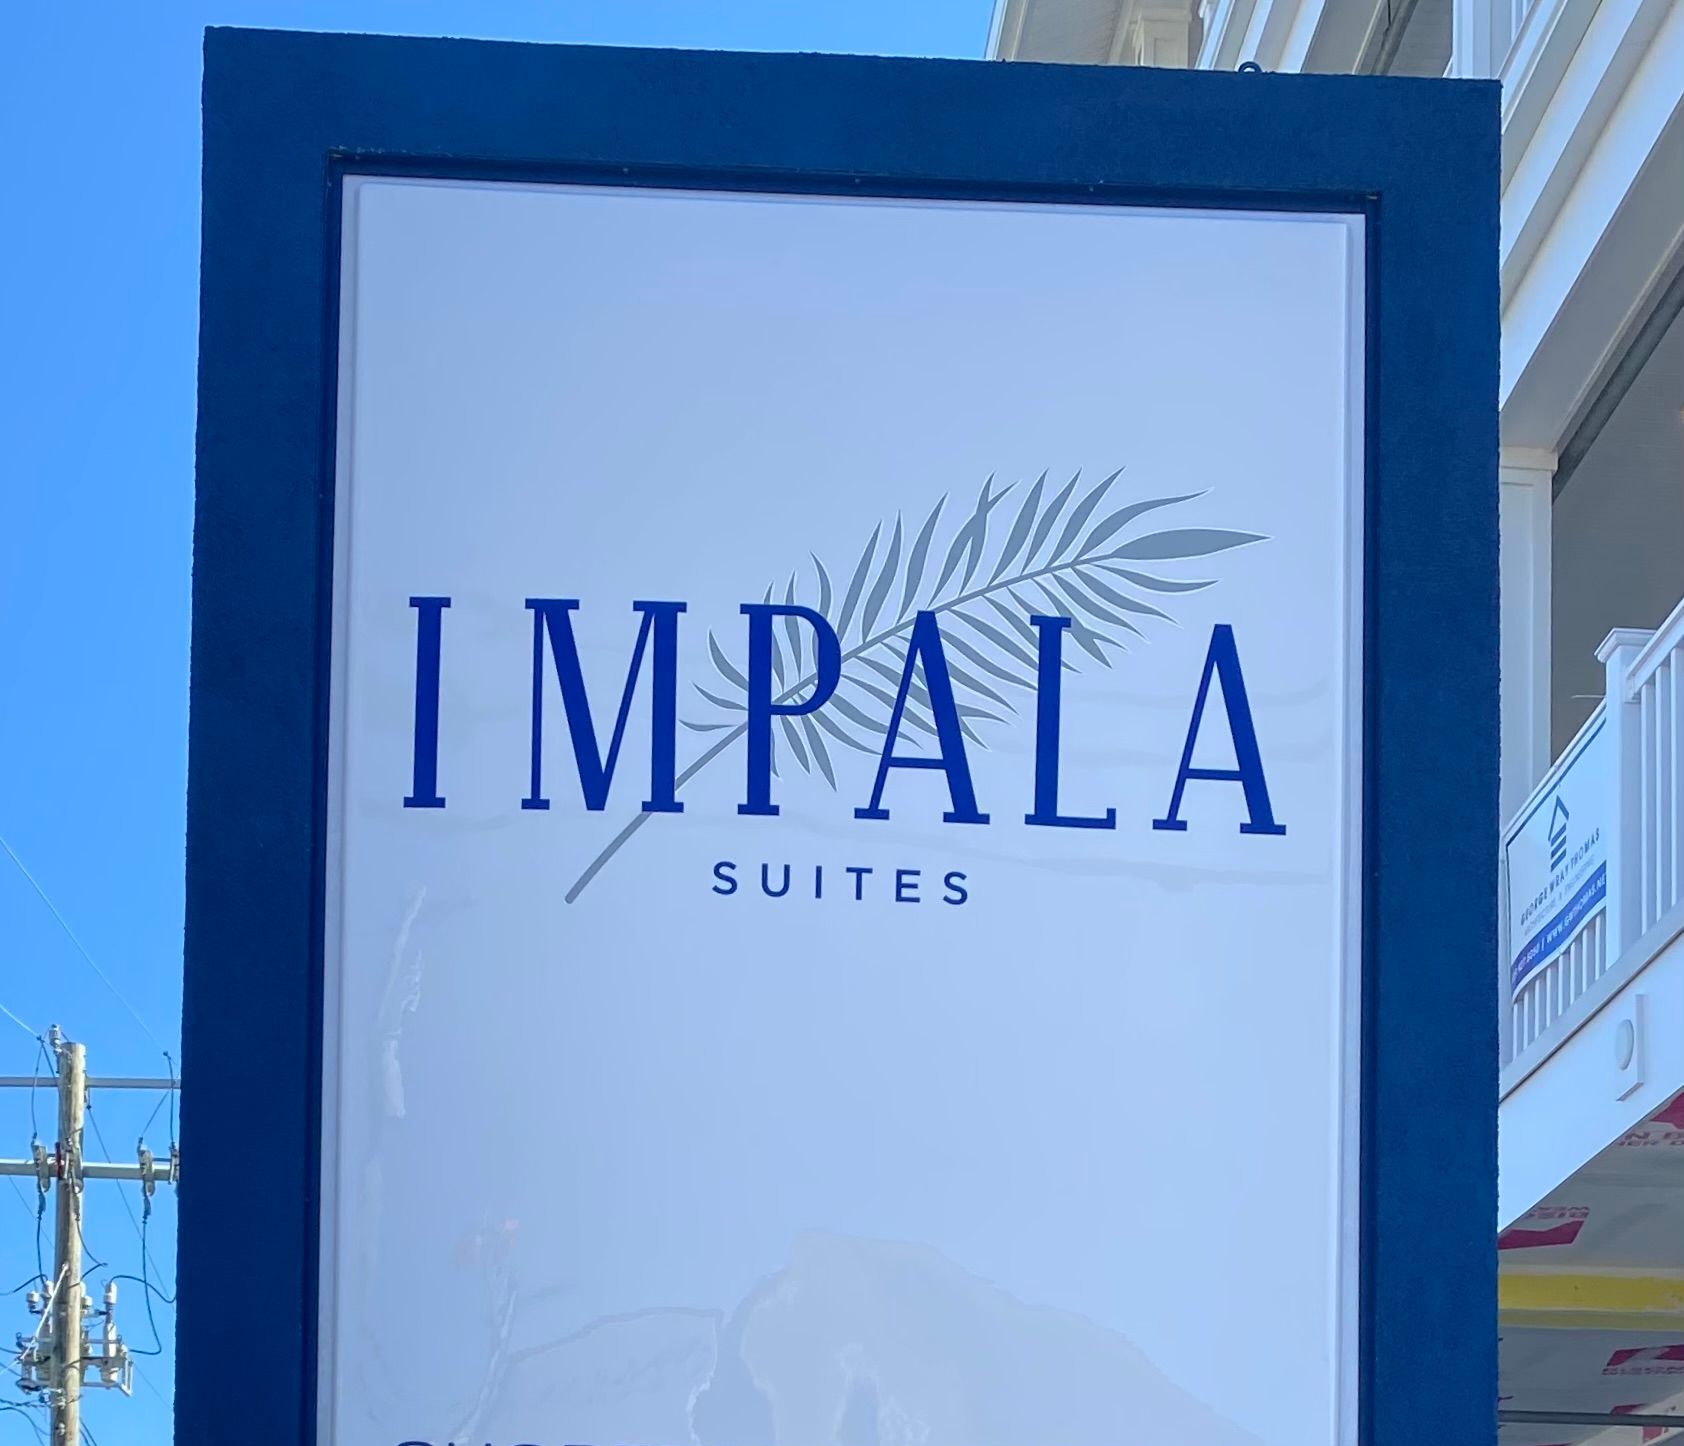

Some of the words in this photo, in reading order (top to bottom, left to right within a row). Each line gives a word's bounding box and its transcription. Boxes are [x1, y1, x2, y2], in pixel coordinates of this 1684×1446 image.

[403, 596, 1287, 837] IMPALA
[1570, 827, 1600, 870] THOMAS
[711, 860, 968, 906] SUITES
